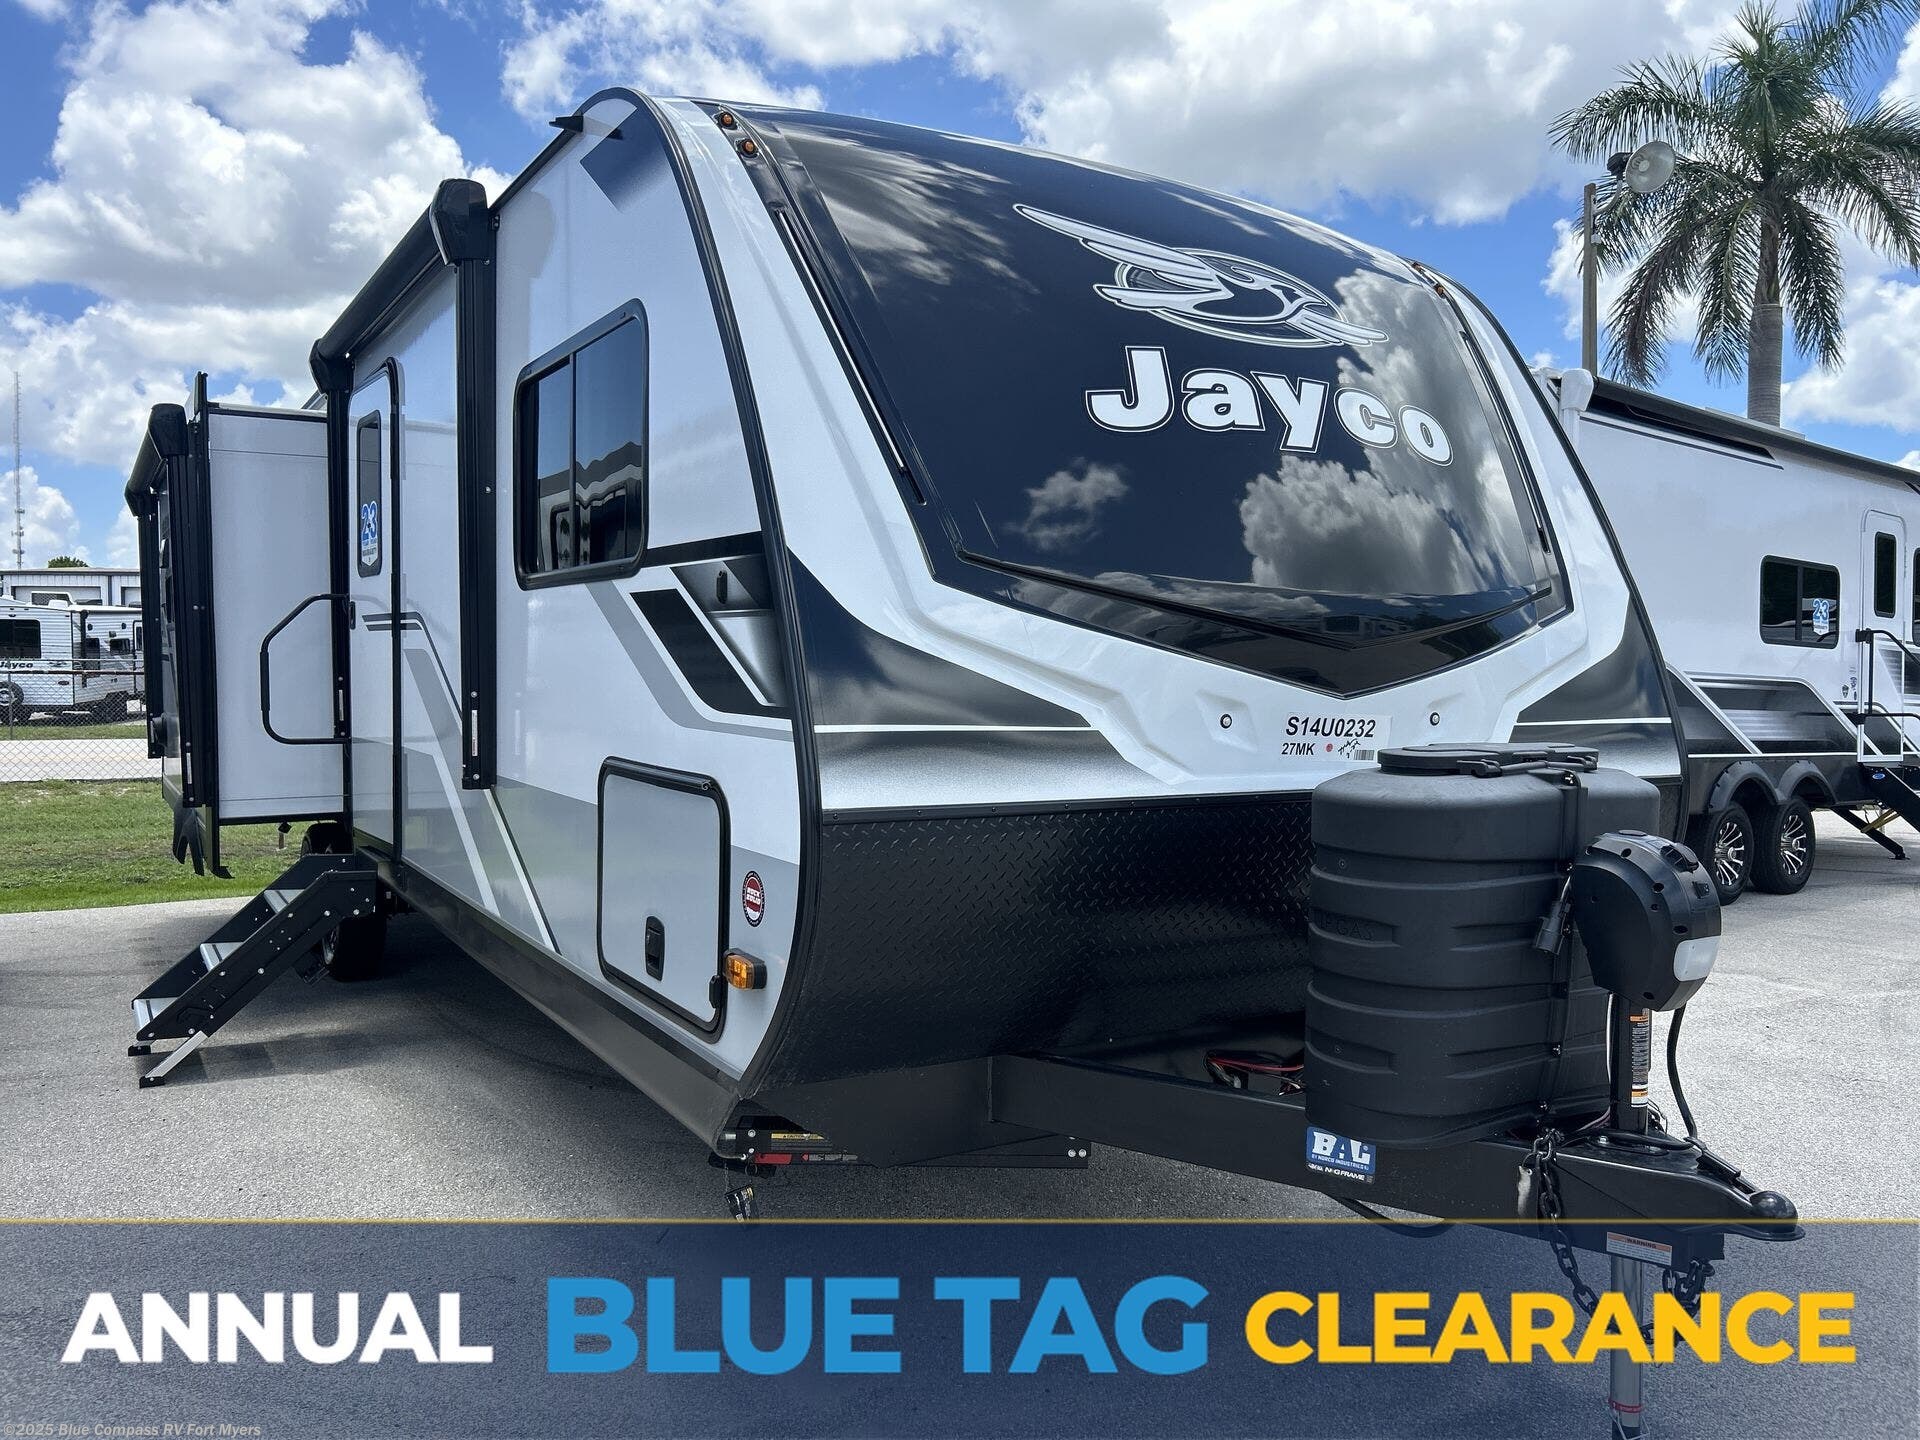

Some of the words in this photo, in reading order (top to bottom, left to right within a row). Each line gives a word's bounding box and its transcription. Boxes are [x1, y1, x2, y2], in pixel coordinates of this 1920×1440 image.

[1085, 346, 1453, 466] Jayco
[361, 501, 378, 541] 23
[1813, 599, 1829, 621] 23
[0, 661, 34, 670] Jayco
[1285, 716, 1376, 738] S14U0232
[1281, 742, 1315, 756] 27MK
[1312, 1131, 1371, 1165] BAL
